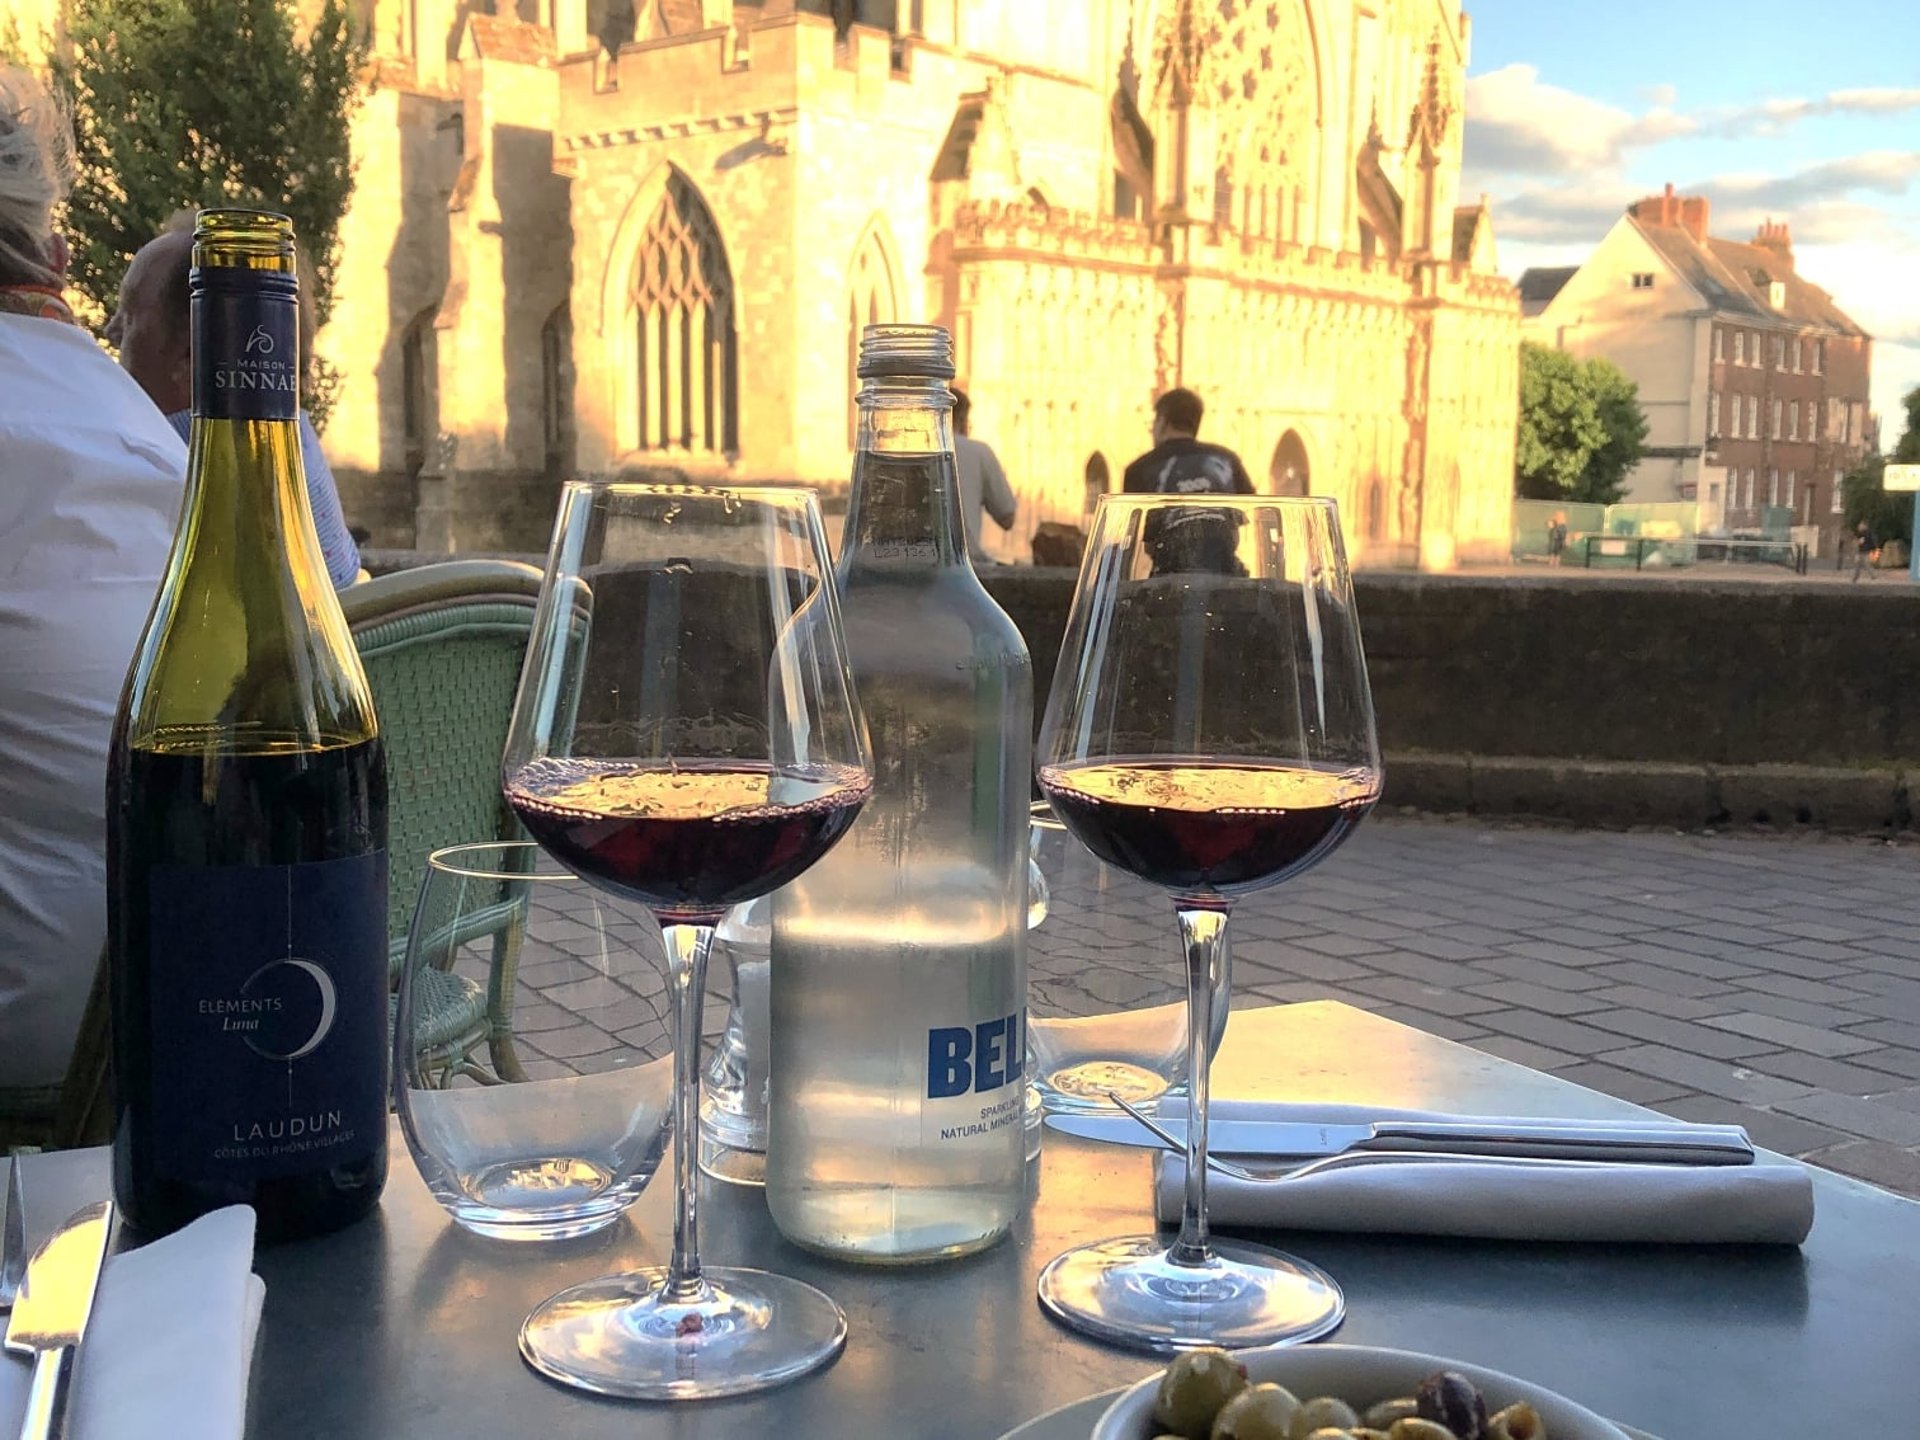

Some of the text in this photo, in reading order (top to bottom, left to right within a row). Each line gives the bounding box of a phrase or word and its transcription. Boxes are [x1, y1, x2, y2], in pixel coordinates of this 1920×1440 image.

[237, 359, 286, 370] MAISON
[223, 1017, 260, 1031] Luna
[928, 1007, 1026, 1098] BEL
[234, 1109, 341, 1141] LAUDUN
[941, 1122, 989, 1140] NATURAL
